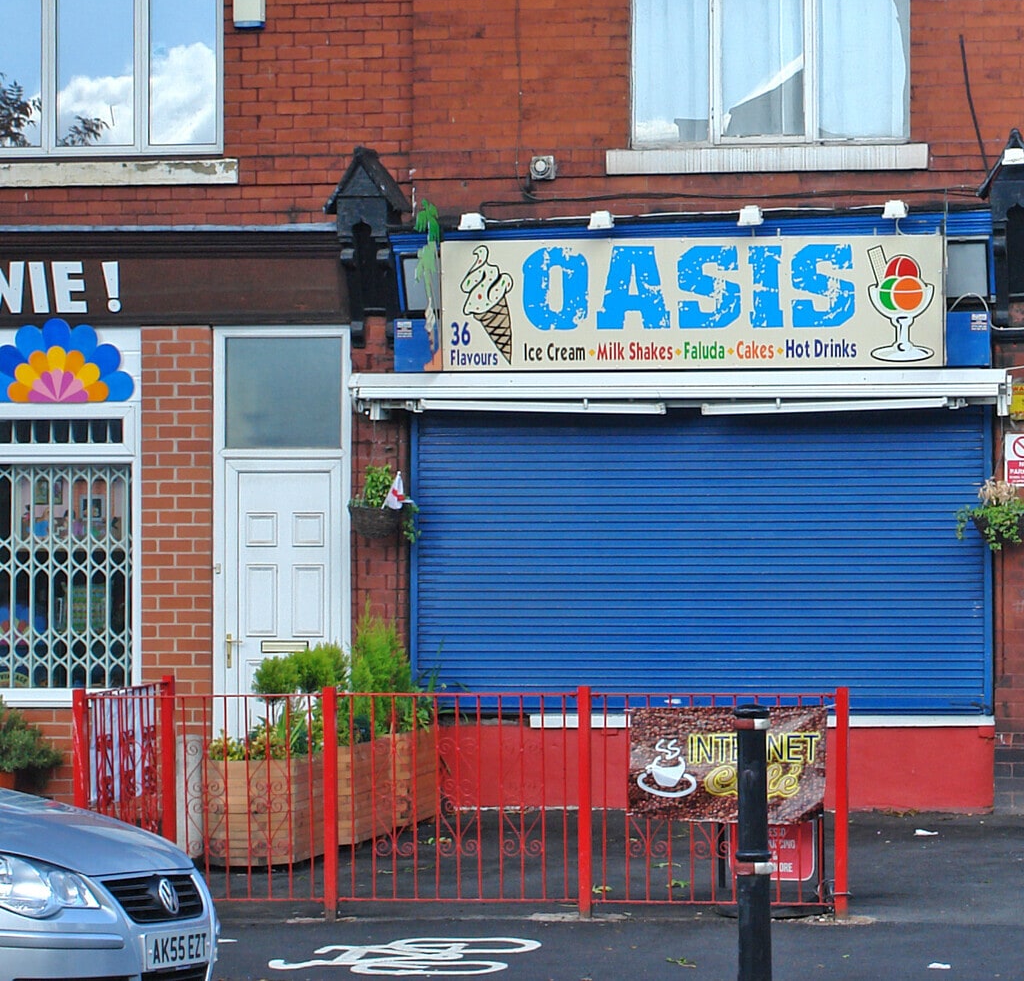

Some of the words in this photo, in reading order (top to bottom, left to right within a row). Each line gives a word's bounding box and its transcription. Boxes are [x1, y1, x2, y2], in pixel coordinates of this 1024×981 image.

[522, 244, 855, 331] OASIS
[450, 322, 471, 346] 36
[450, 349, 498, 366] Flavours
[524, 342, 542, 361] Ice
[546, 342, 586, 361] Cream
[597, 342, 625, 360] Milk
[629, 341, 673, 360] Shakes
[684, 341, 725, 360] Faluda
[736, 340, 774, 359] Cakes
[785, 339, 810, 359] Hot
[814, 338, 857, 358] Drinks
[153, 936, 186, 964] AK55
[188, 932, 207, 959] EZT
